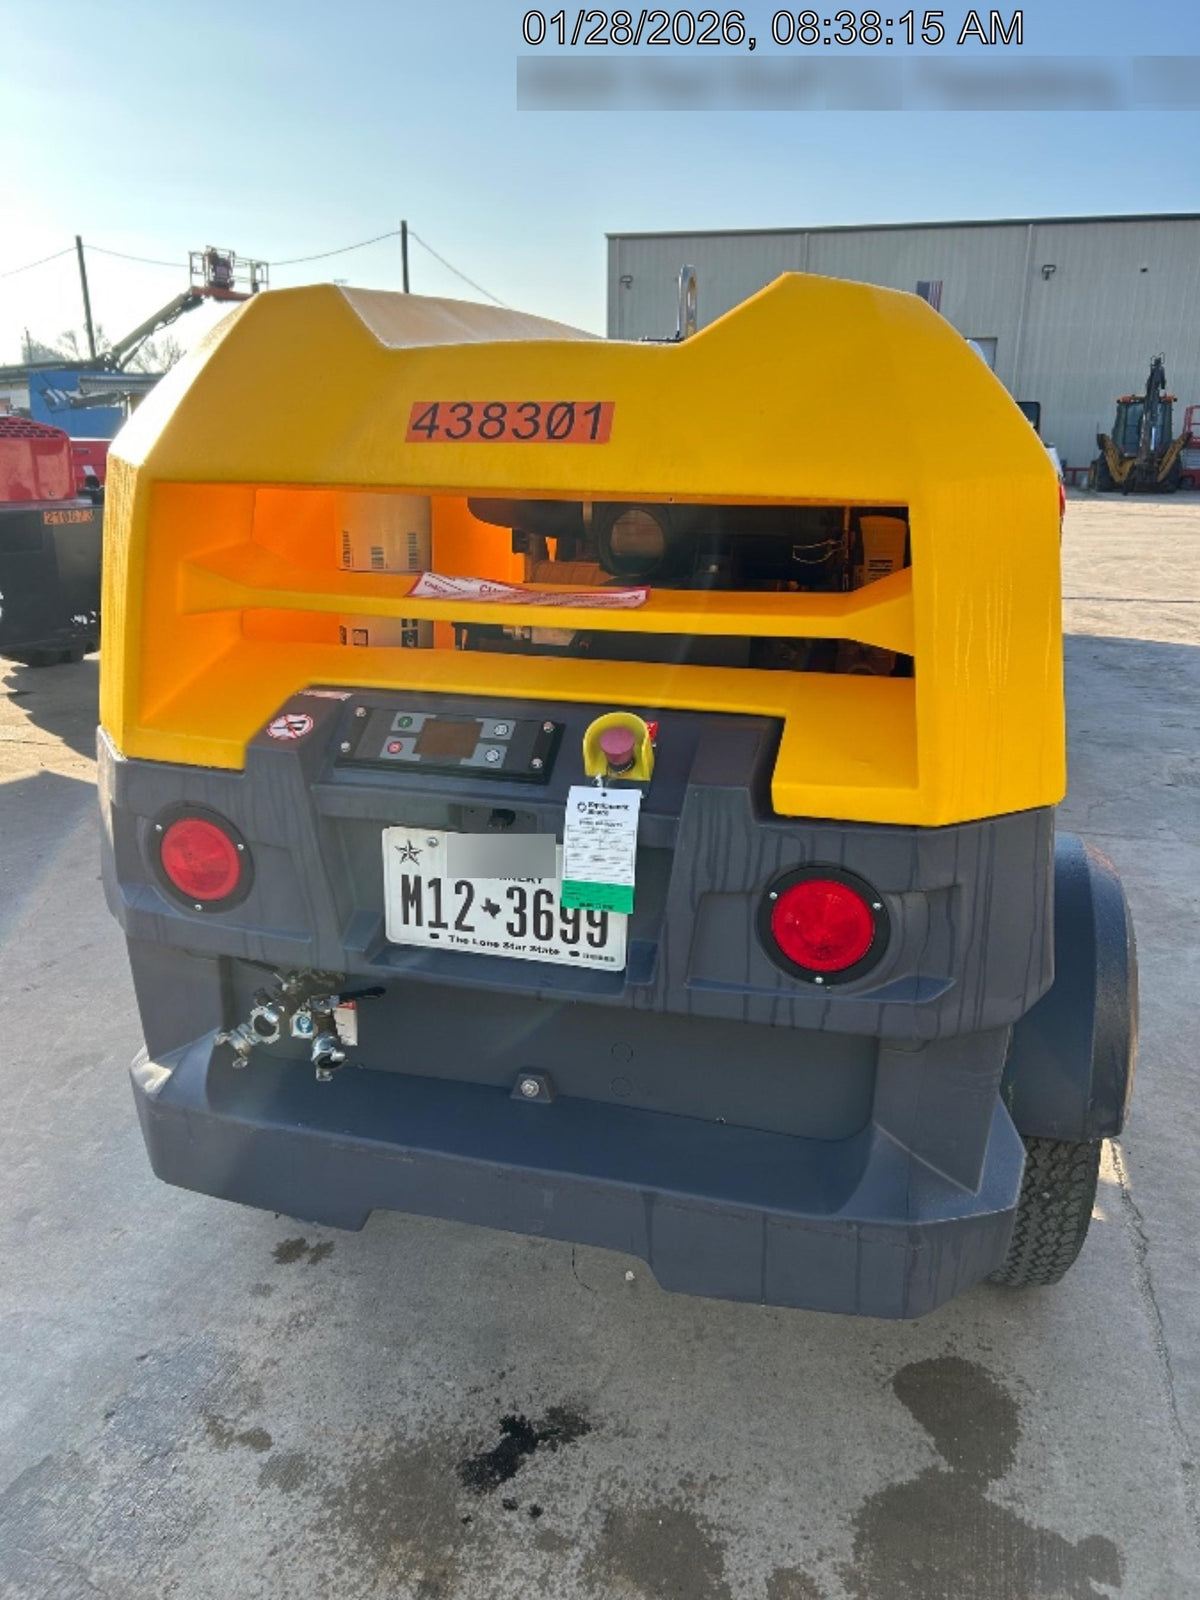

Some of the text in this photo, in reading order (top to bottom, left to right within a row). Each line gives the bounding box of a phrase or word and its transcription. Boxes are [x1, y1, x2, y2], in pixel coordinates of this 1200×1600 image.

[411, 401, 602, 440] 438301
[401, 874, 475, 932] M12
[448, 934, 470, 945] The
[472, 937, 500, 949] Lone
[502, 941, 527, 952] Star
